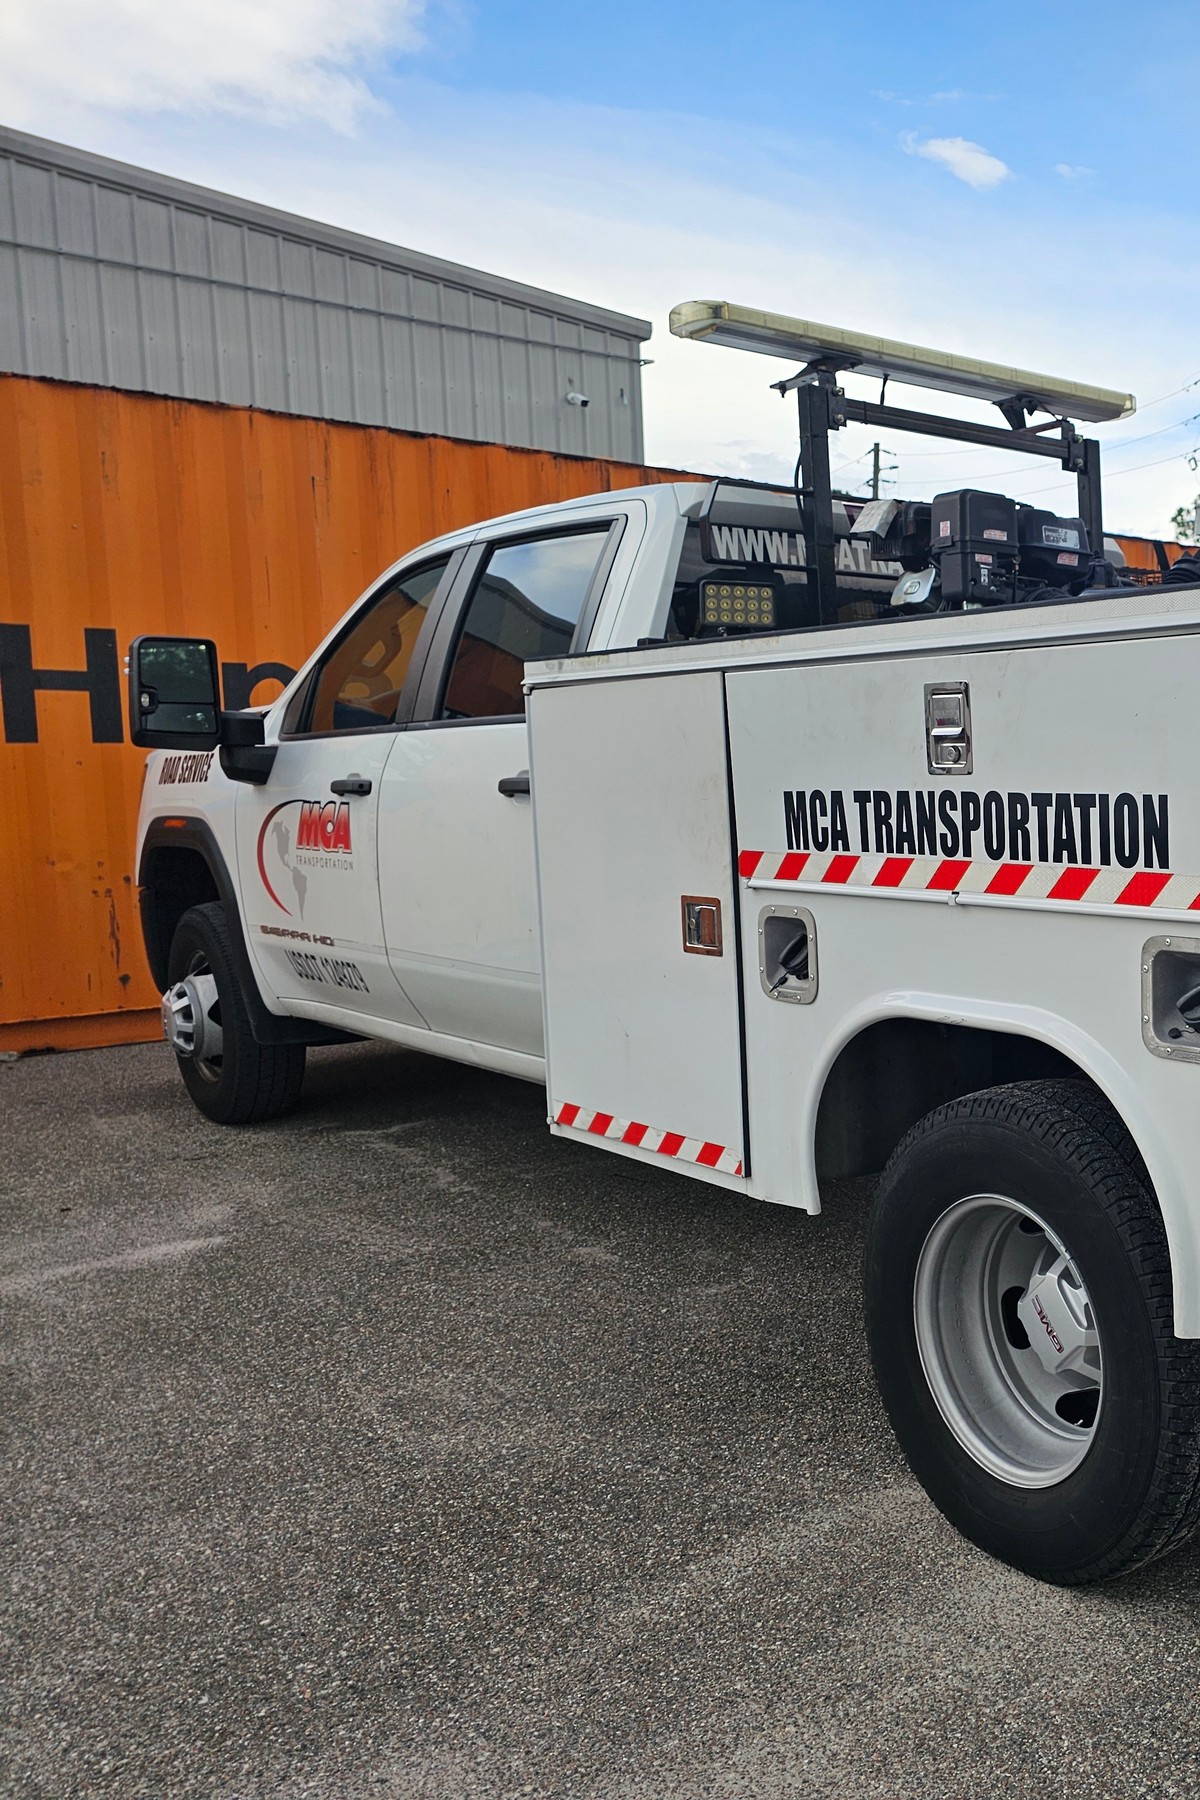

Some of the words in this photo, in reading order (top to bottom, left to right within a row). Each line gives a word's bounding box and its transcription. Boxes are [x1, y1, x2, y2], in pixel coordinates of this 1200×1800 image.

[158, 756, 183, 785] ROAD
[177, 752, 214, 784] SERVICE
[295, 800, 353, 855] MCA
[783, 789, 850, 852] MCA
[852, 789, 1170, 870] TRANSPORTATION
[295, 855, 354, 871] TRANSPORTATION
[260, 925, 312, 943] SIERRA
[312, 933, 335, 947] HD
[283, 948, 329, 984] USDOT
[1031, 1294, 1065, 1355] GMC
